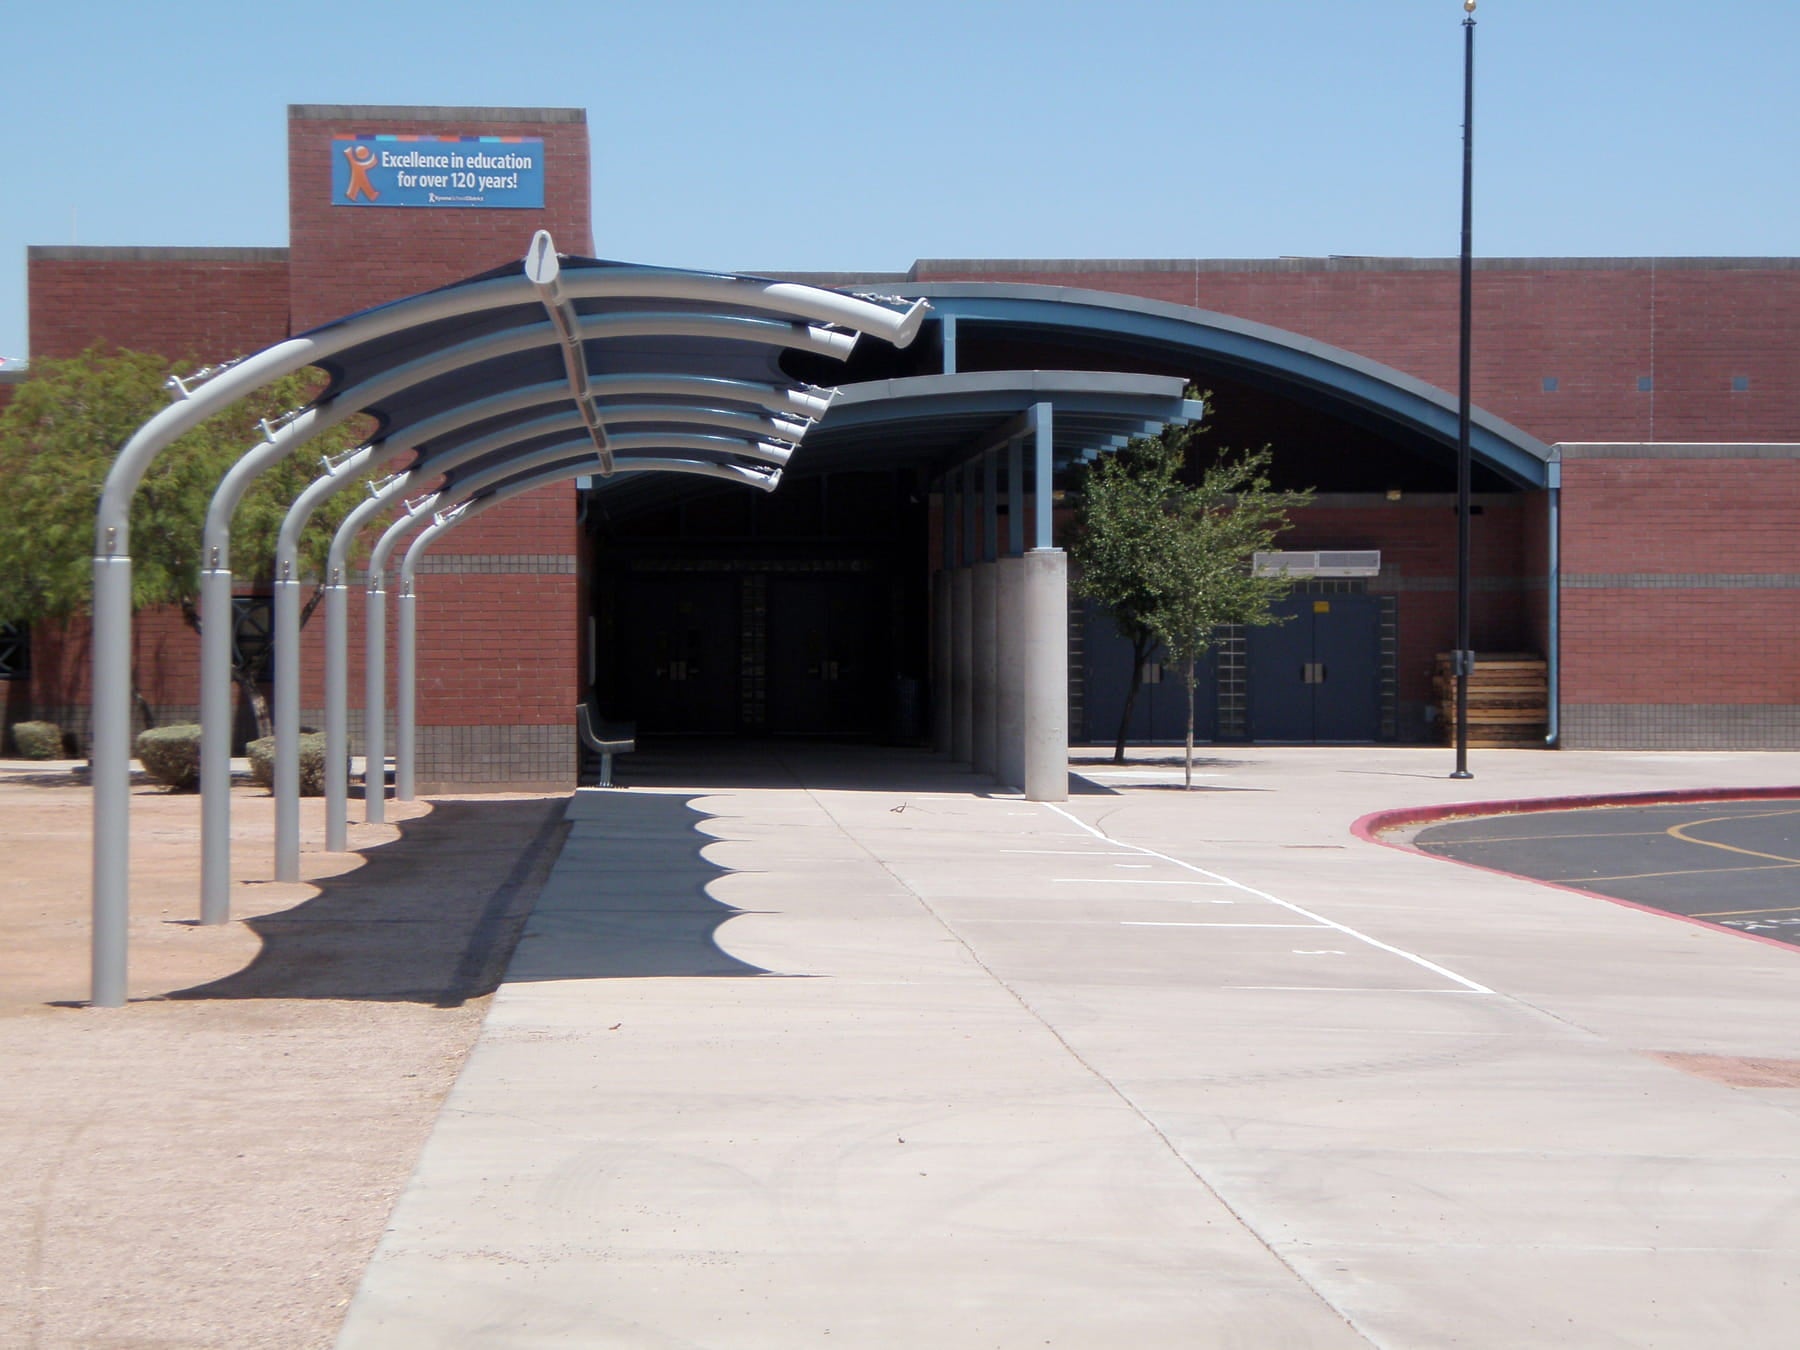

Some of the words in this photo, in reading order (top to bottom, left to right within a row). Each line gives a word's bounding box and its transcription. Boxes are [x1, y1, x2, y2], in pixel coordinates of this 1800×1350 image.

[382, 151, 449, 168] Excellence
[451, 152, 464, 168] in
[466, 153, 532, 169] education
[397, 171, 417, 187] for
[419, 175, 448, 188] over
[450, 173, 475, 188] 120
[478, 173, 518, 192] years!
